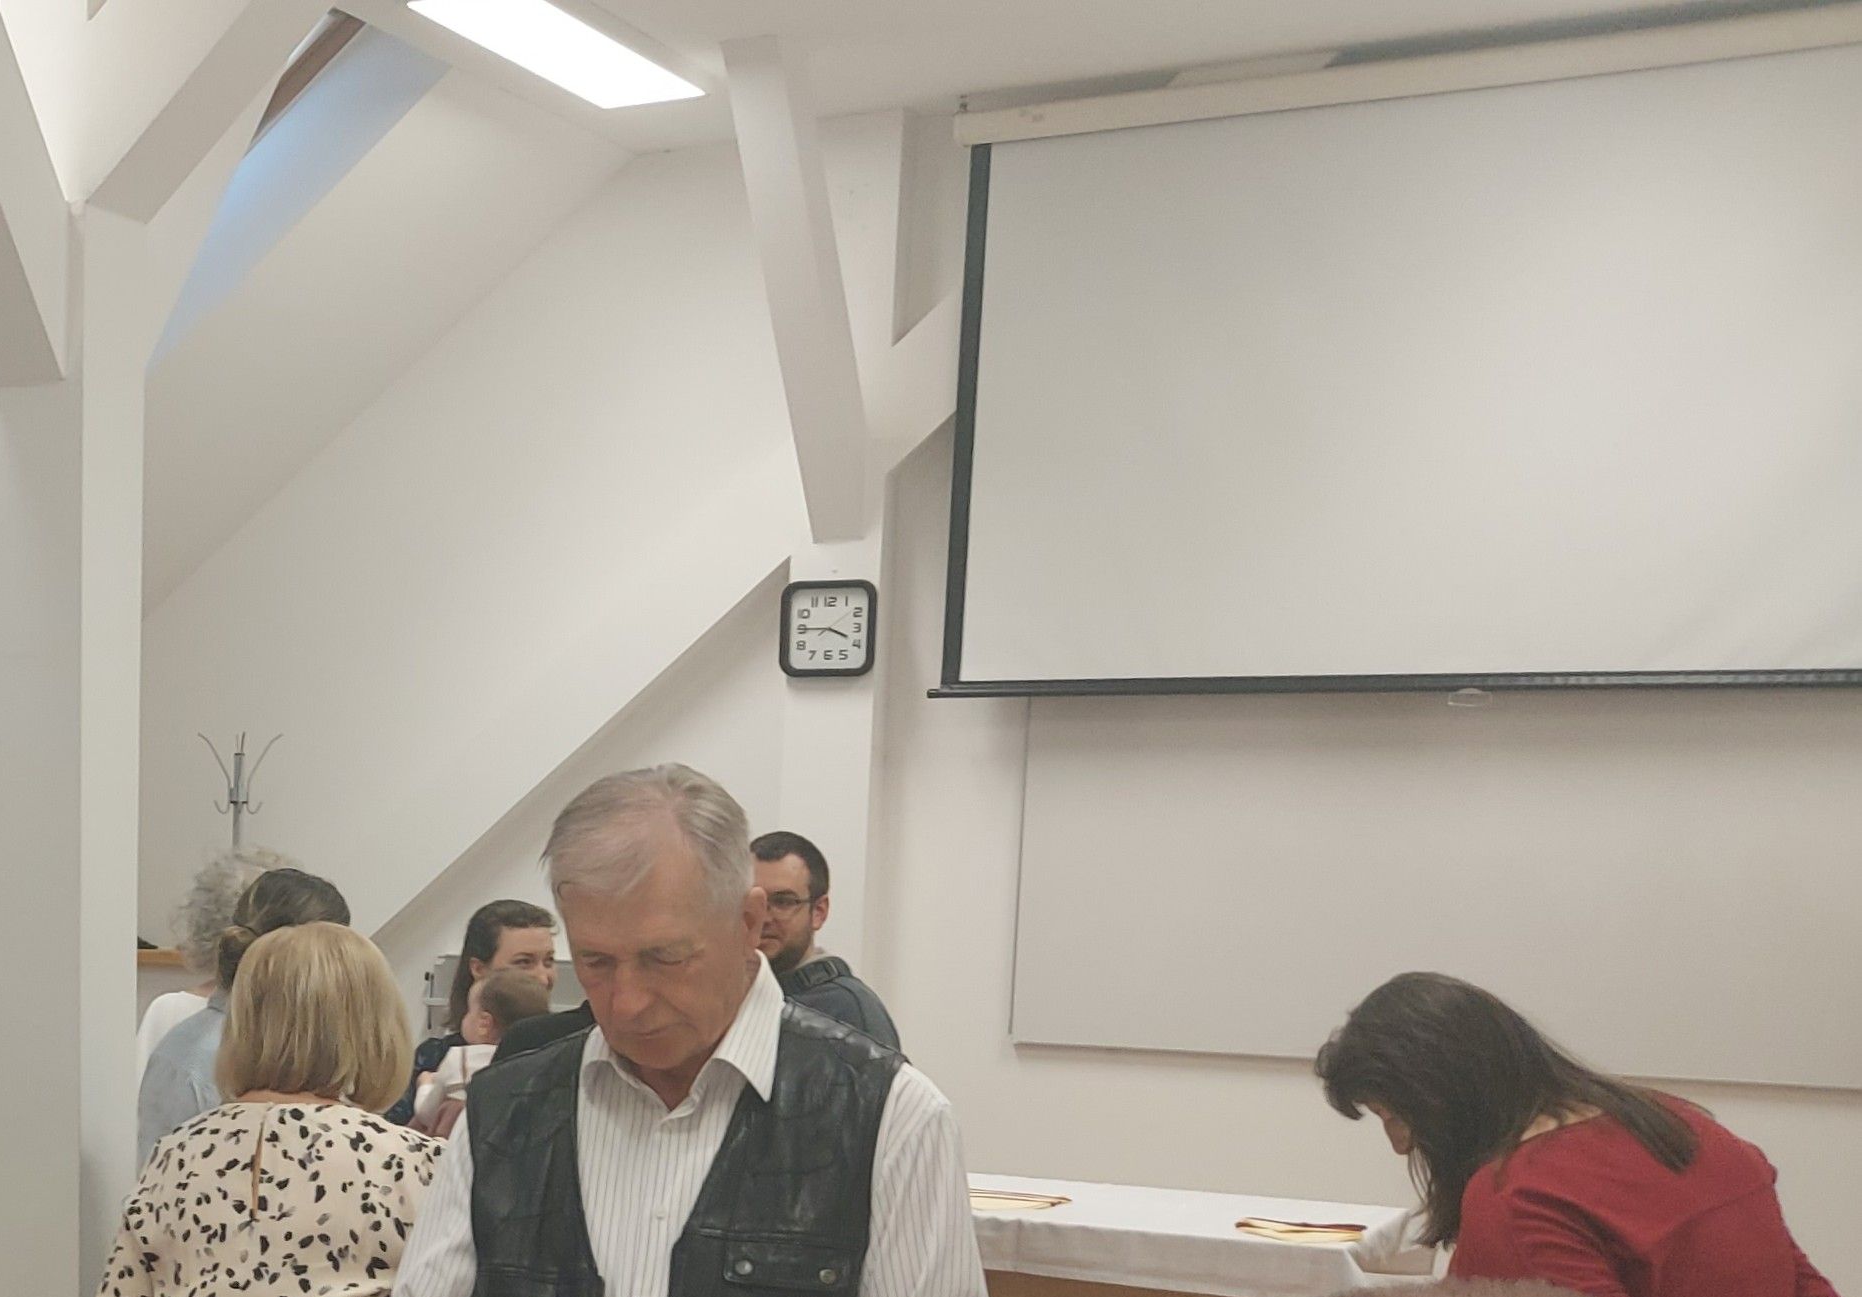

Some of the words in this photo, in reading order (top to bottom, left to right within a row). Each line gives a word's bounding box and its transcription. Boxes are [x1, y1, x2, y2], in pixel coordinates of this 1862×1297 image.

[811, 596, 819, 608] 11
[823, 596, 838, 608] 12
[797, 608, 811, 619] 10
[852, 606, 863, 617] 2
[797, 623, 808, 635] 9
[852, 622, 862, 633] 3
[796, 640, 807, 651] 8
[808, 649, 818, 661] 7
[823, 649, 834, 661] 6
[838, 649, 849, 661] 5
